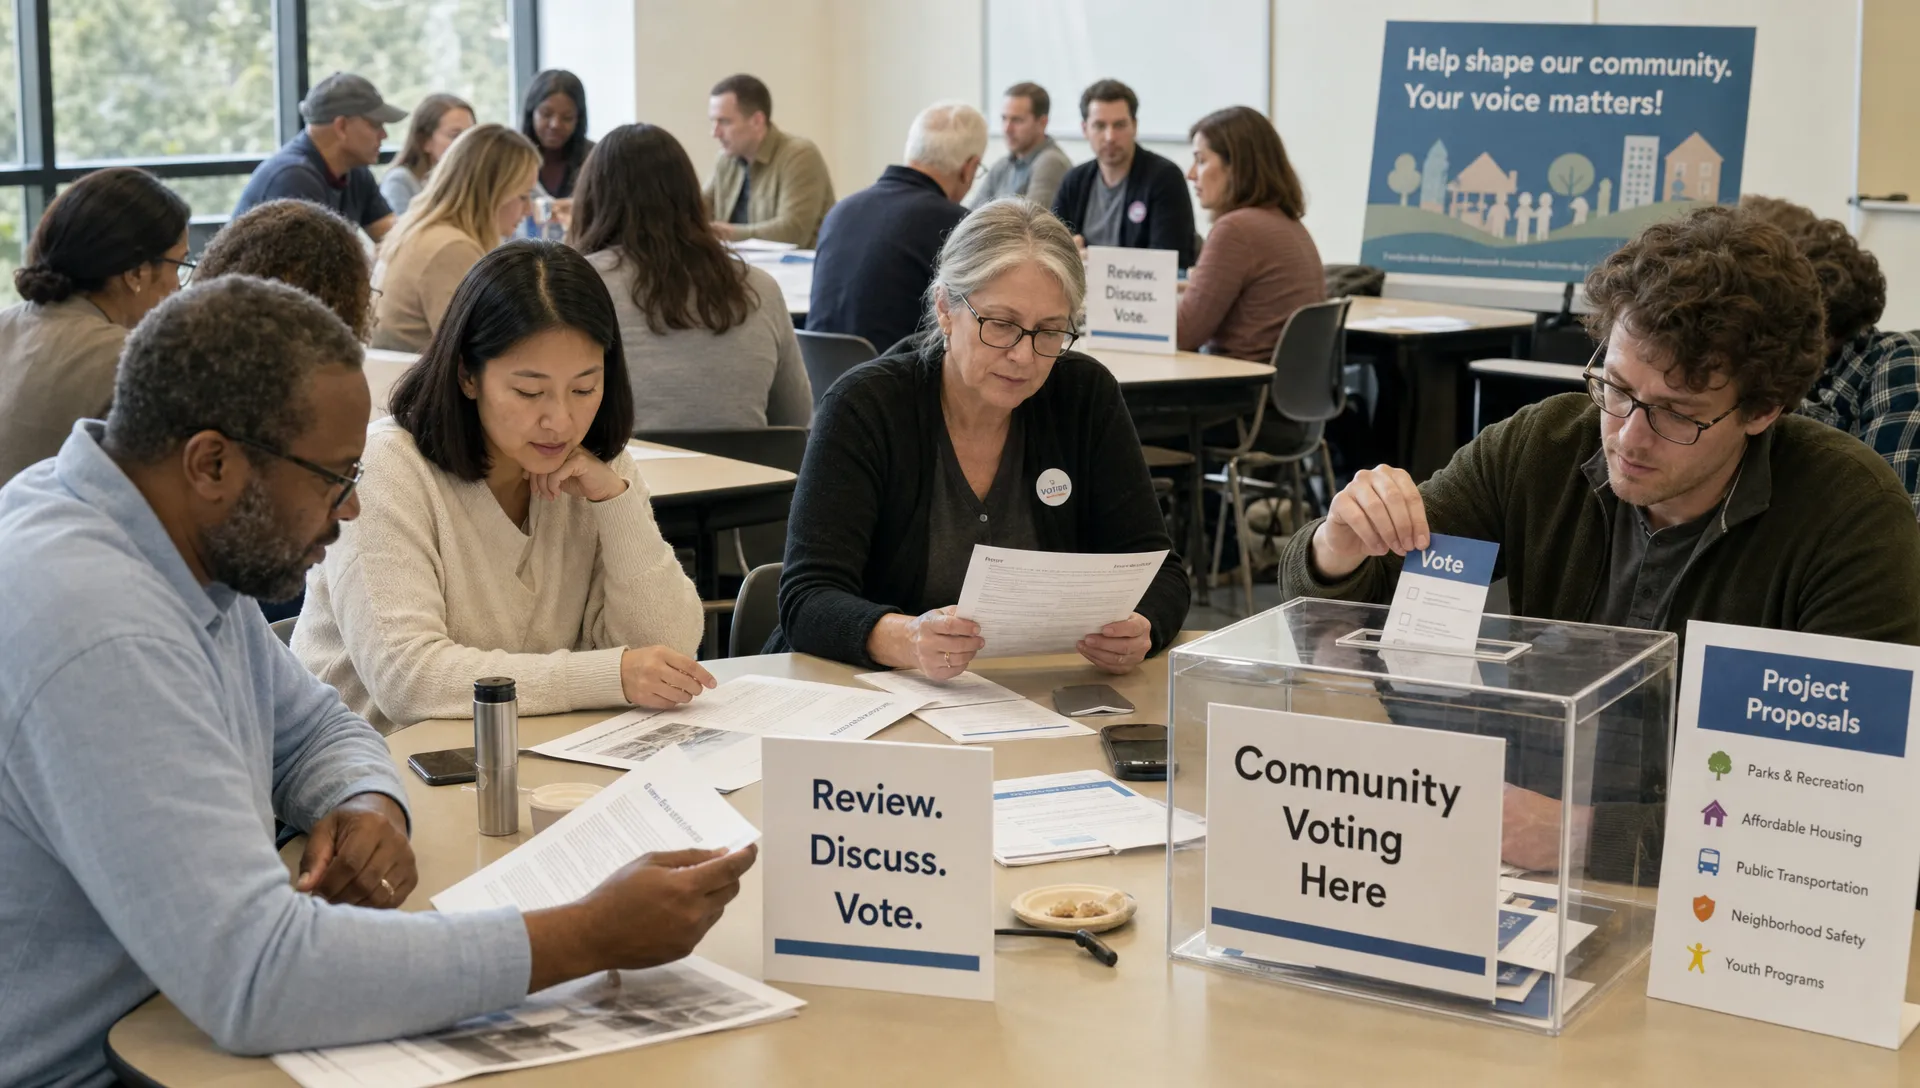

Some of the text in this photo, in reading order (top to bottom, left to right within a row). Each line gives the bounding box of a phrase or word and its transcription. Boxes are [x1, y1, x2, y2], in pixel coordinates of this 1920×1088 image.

[1406, 46, 1732, 83] Help shape our community.
[1404, 82, 1664, 116] Your voice matters!
[1107, 263, 1157, 281] Review.
[1106, 284, 1157, 303] Discuss.
[1113, 307, 1147, 324] Vote.
[1421, 550, 1464, 574] Vote
[1762, 668, 1850, 702] Project
[1746, 697, 1861, 734] Proposals
[1234, 745, 1462, 818] Community
[1748, 763, 1864, 794] Parks & Recreation
[812, 778, 943, 819] Review.
[1282, 805, 1403, 866] Voting
[1742, 813, 1863, 848] Affordable Housing
[810, 833, 947, 877] Discuss.
[1301, 861, 1387, 908] Here
[1736, 860, 1869, 896] Public Transportation
[834, 891, 923, 930] Vote.
[1731, 908, 1866, 949] Neighborhood Safety
[1725, 956, 1825, 990] Youth Programs
